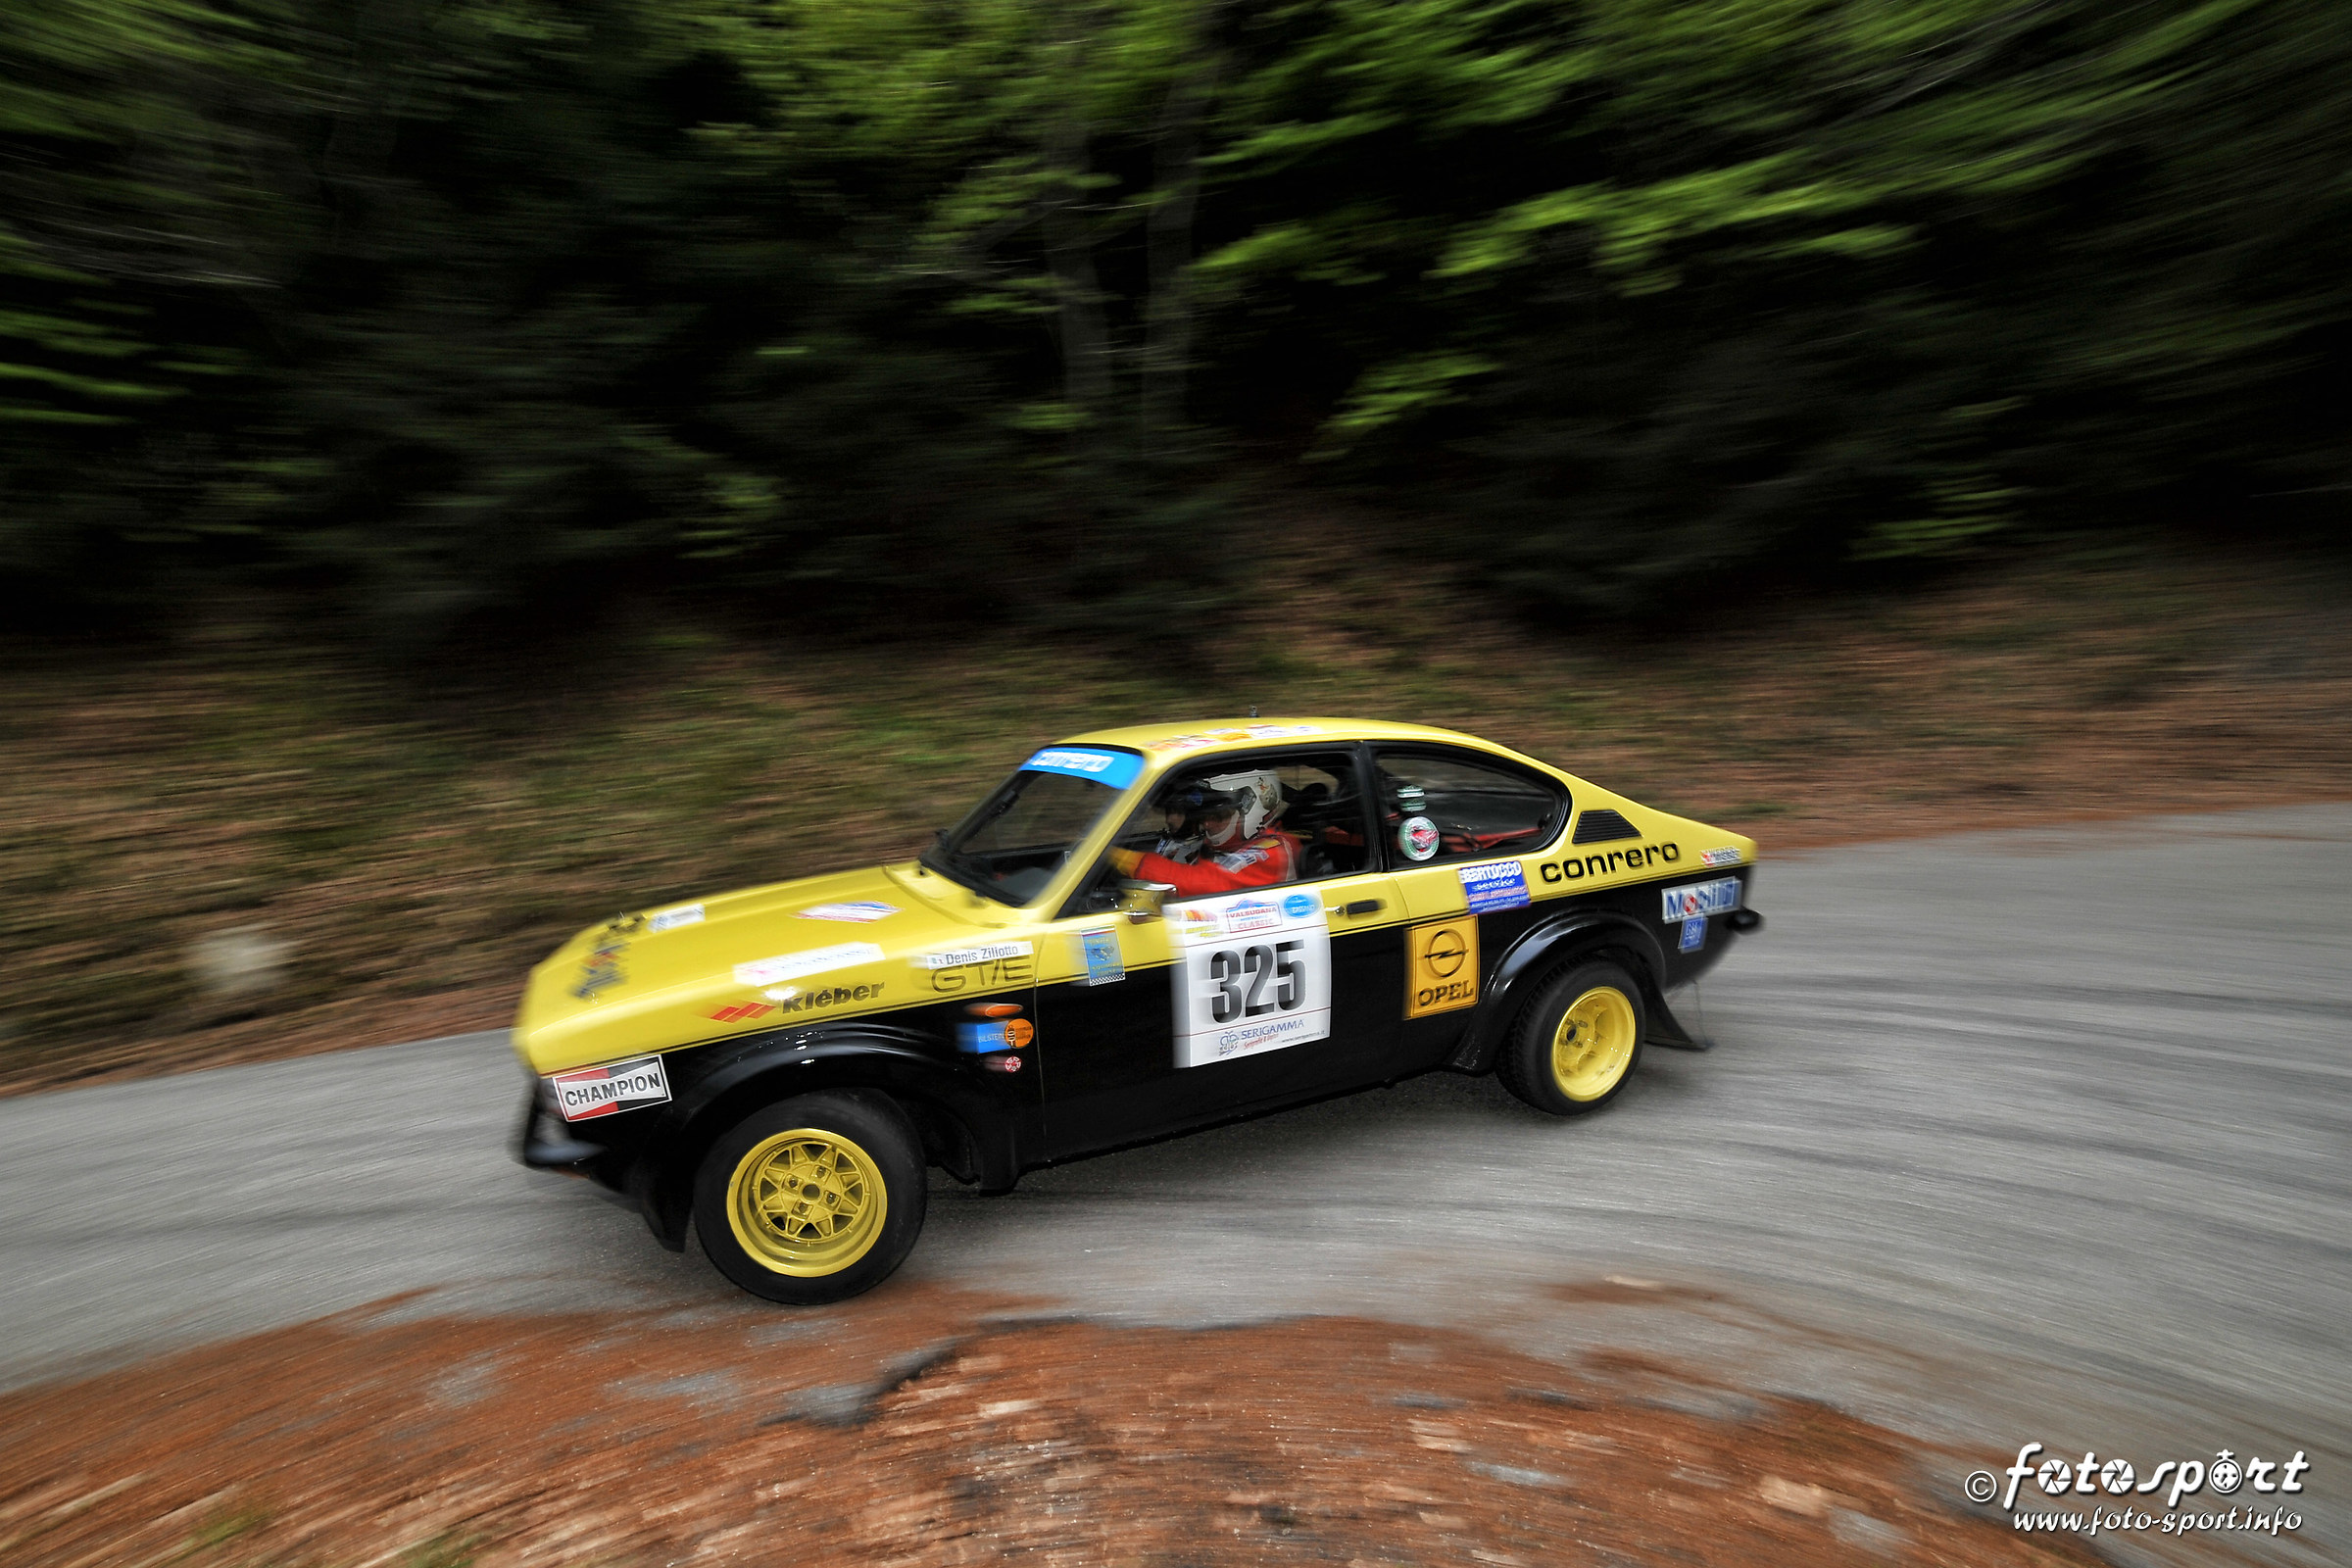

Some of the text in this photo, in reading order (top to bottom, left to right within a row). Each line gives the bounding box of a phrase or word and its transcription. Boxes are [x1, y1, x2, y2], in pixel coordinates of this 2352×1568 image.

[1541, 843, 1680, 884] conrero
[946, 945, 1019, 965] Denis Ziliotto
[931, 956, 1034, 993] GT/E
[1210, 939, 1306, 1023] 325
[1418, 980, 1474, 1006] OPEL
[1241, 1019, 1305, 1041] SERIGAMMA
[564, 1072, 662, 1106] CHAMPION
